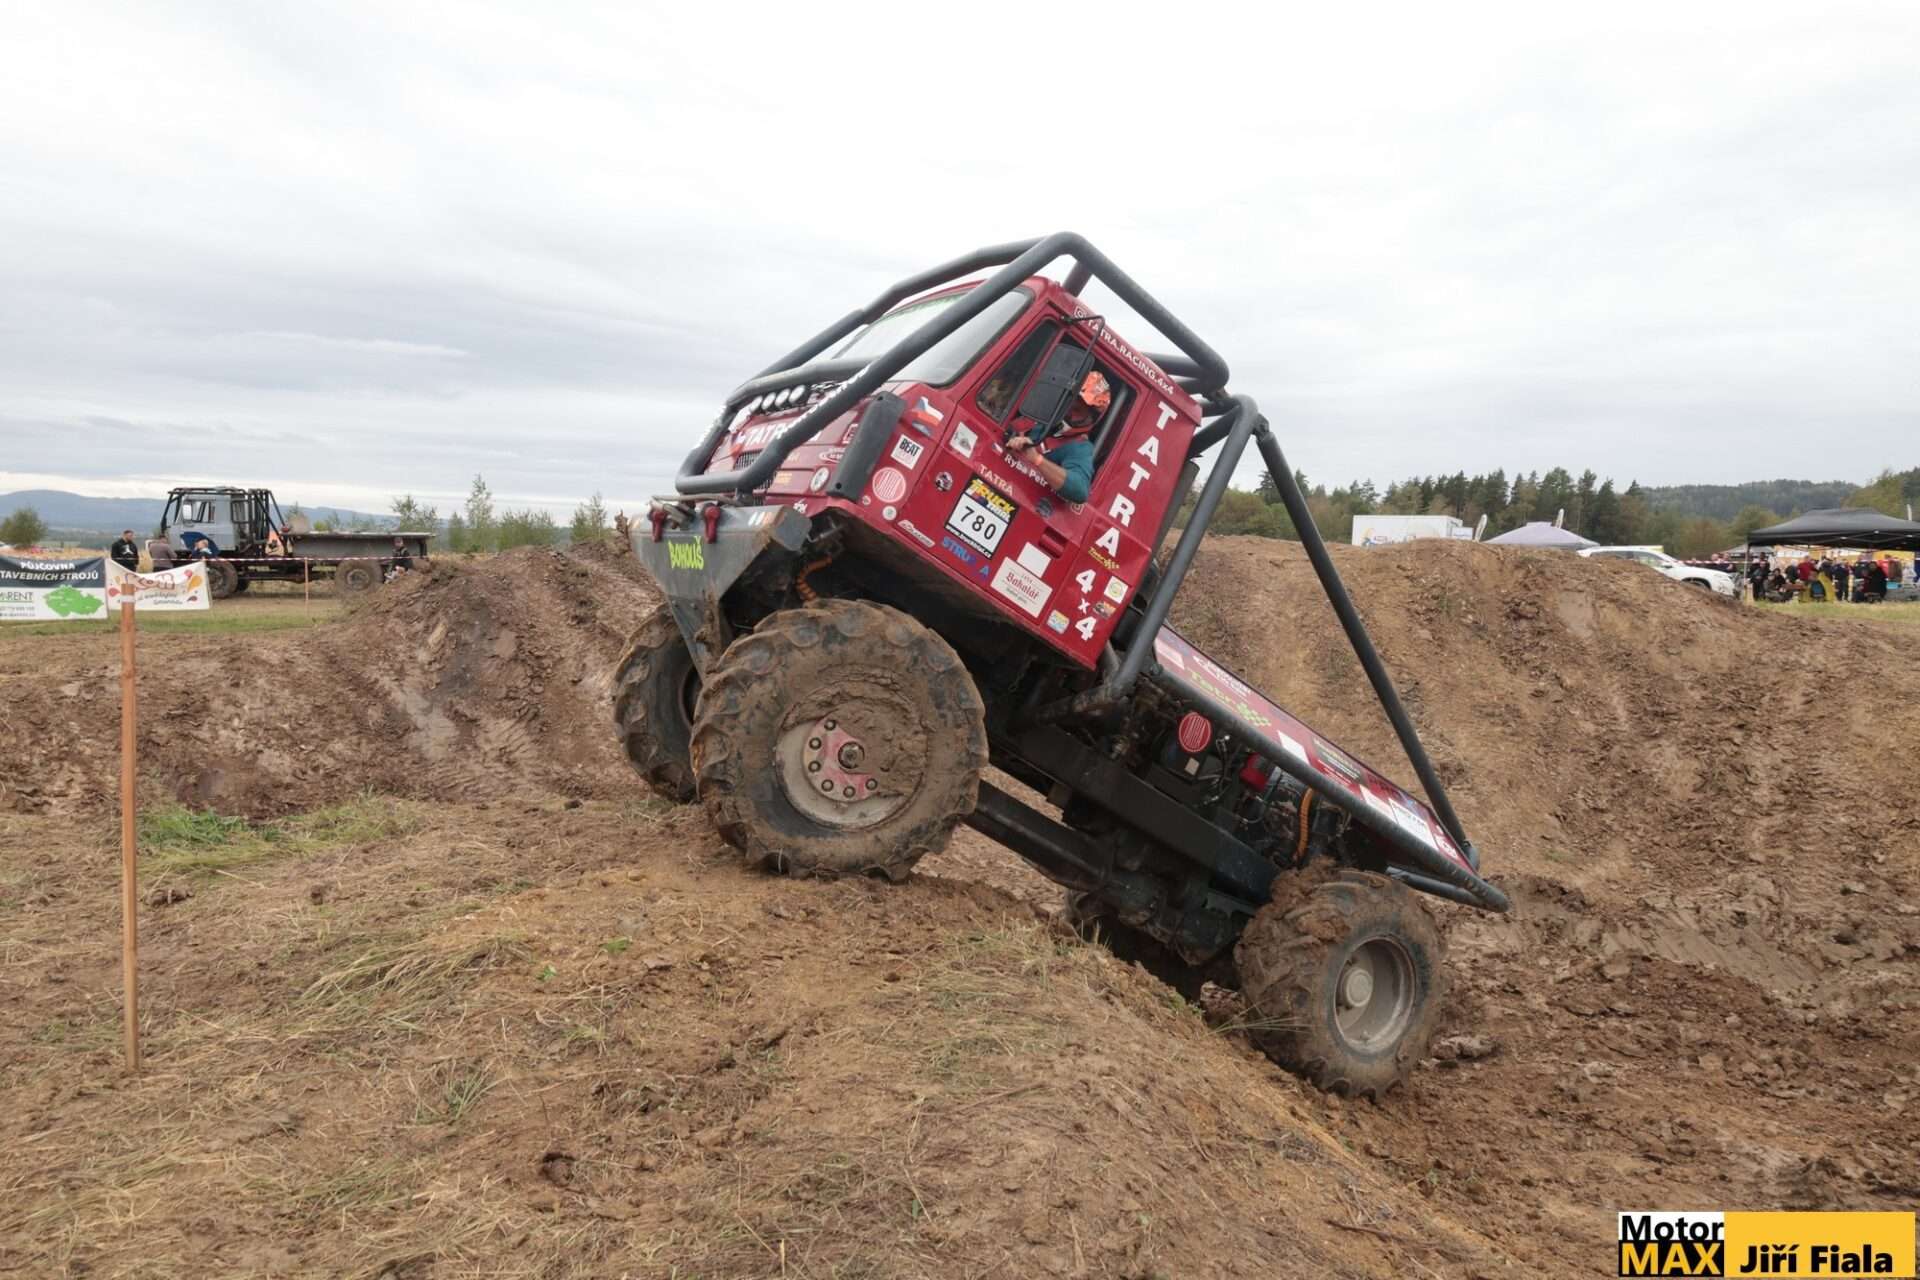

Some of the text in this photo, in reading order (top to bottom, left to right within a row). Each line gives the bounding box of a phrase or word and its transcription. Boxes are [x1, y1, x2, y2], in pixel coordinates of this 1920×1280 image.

[899, 437, 920, 457] BEAT
[969, 478, 1016, 514] TRUCK
[979, 463, 1014, 496] TATRA
[1096, 401, 1178, 557] TATRA
[964, 505, 998, 542] 780
[0, 570, 99, 581] TAVEBNÍCH STROJŮ
